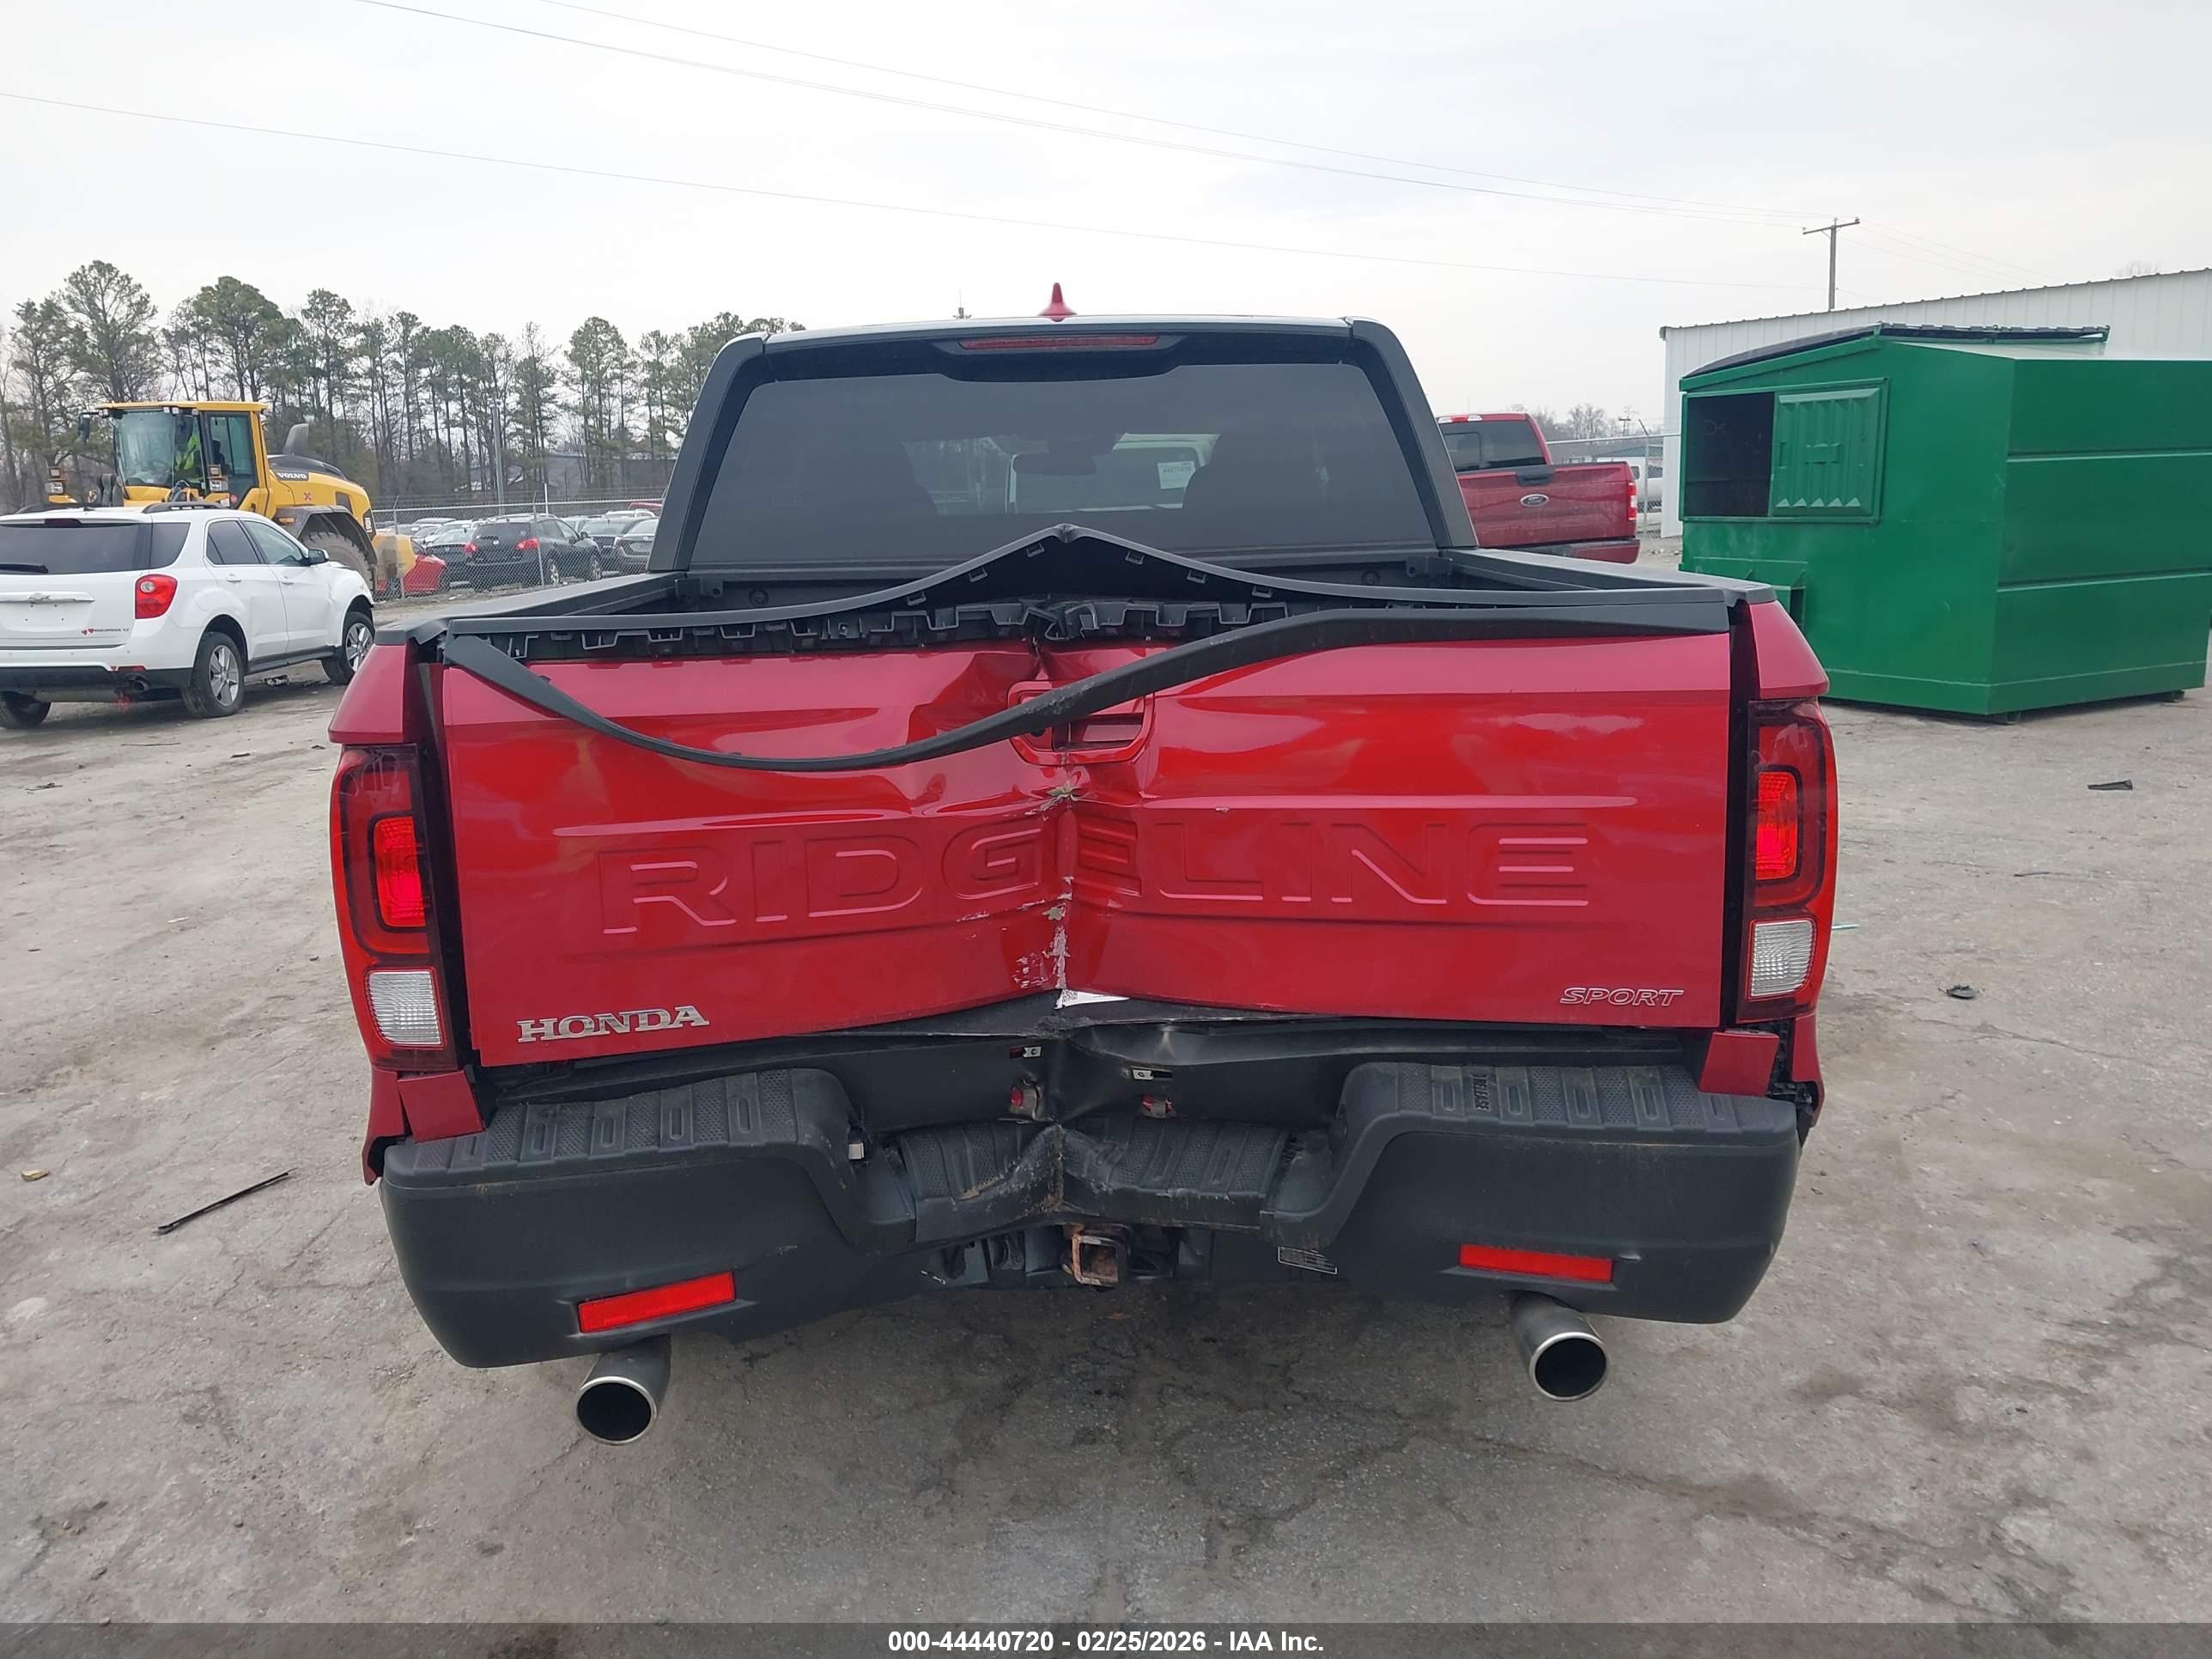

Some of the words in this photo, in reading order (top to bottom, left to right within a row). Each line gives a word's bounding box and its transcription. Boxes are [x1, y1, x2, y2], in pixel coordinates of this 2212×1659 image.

[599, 814, 1589, 933] RIDGELINE
[1559, 987, 1685, 1006] SPORT
[516, 1005, 711, 1043] HONDA
